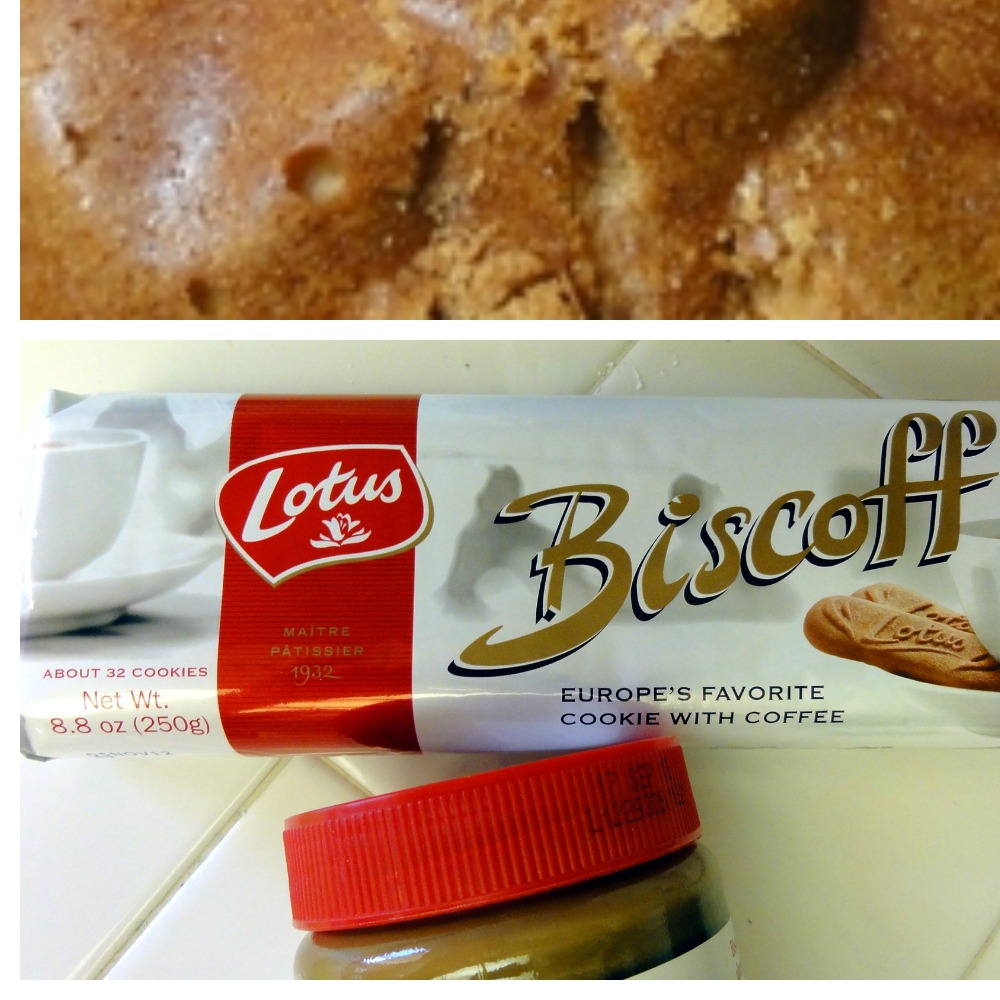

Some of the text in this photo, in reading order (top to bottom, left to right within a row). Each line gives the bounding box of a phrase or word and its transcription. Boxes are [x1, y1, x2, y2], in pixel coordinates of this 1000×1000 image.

[241, 461, 403, 543] Lotus
[447, 409, 1000, 679] Biscoff
[42, 667, 209, 680] ABOUT 32 COOKIES
[290, 664, 343, 687] 1932
[82, 689, 169, 710] Net Wt.
[561, 685, 825, 703] EUROPE'S FAVORITE
[50, 715, 211, 736] 8.8 oz (250g)
[560, 710, 846, 726] COOKIE WITH COFFEE
